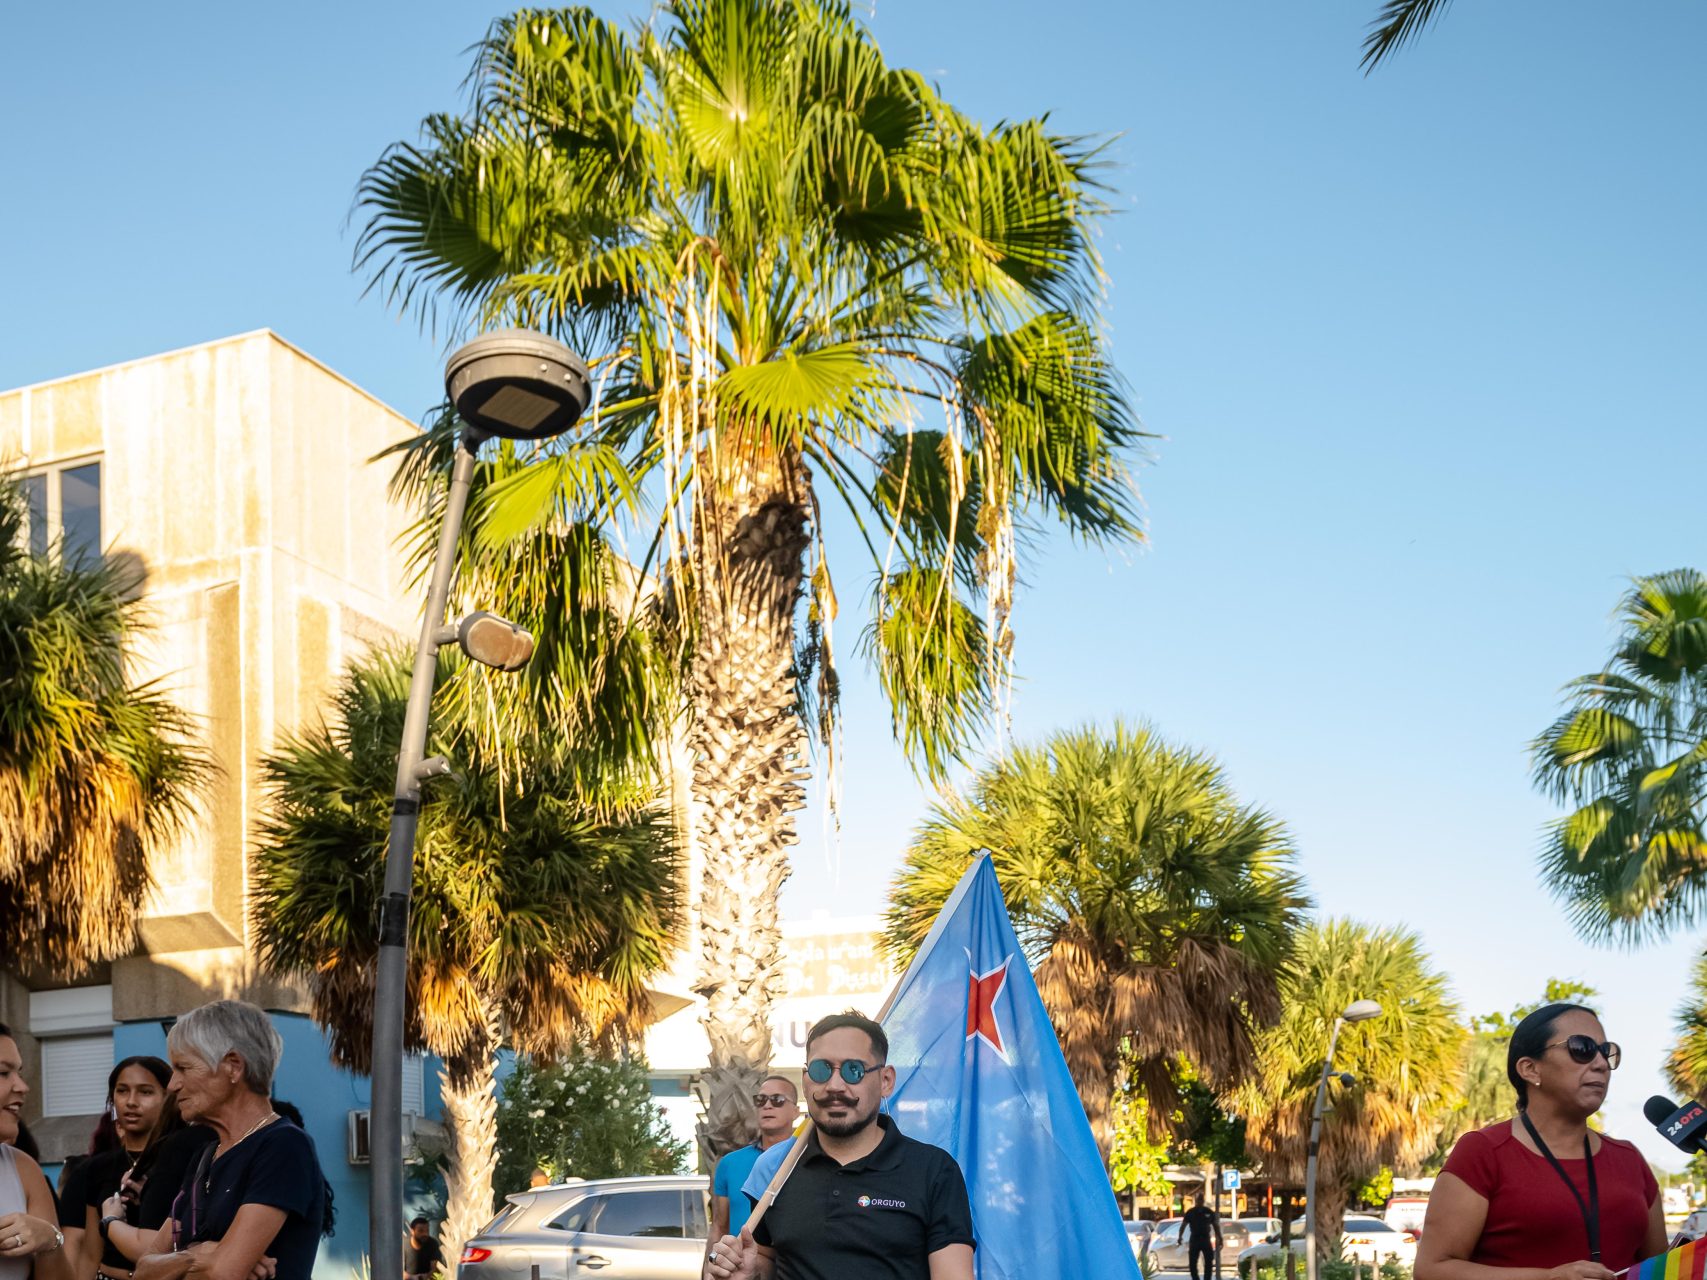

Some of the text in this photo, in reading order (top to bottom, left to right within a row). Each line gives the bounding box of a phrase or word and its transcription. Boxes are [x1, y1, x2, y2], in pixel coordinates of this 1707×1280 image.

[1667, 1107, 1704, 1136] 24ora
[1227, 1172, 1237, 1187] P
[871, 1198, 906, 1208] ORGUYO
